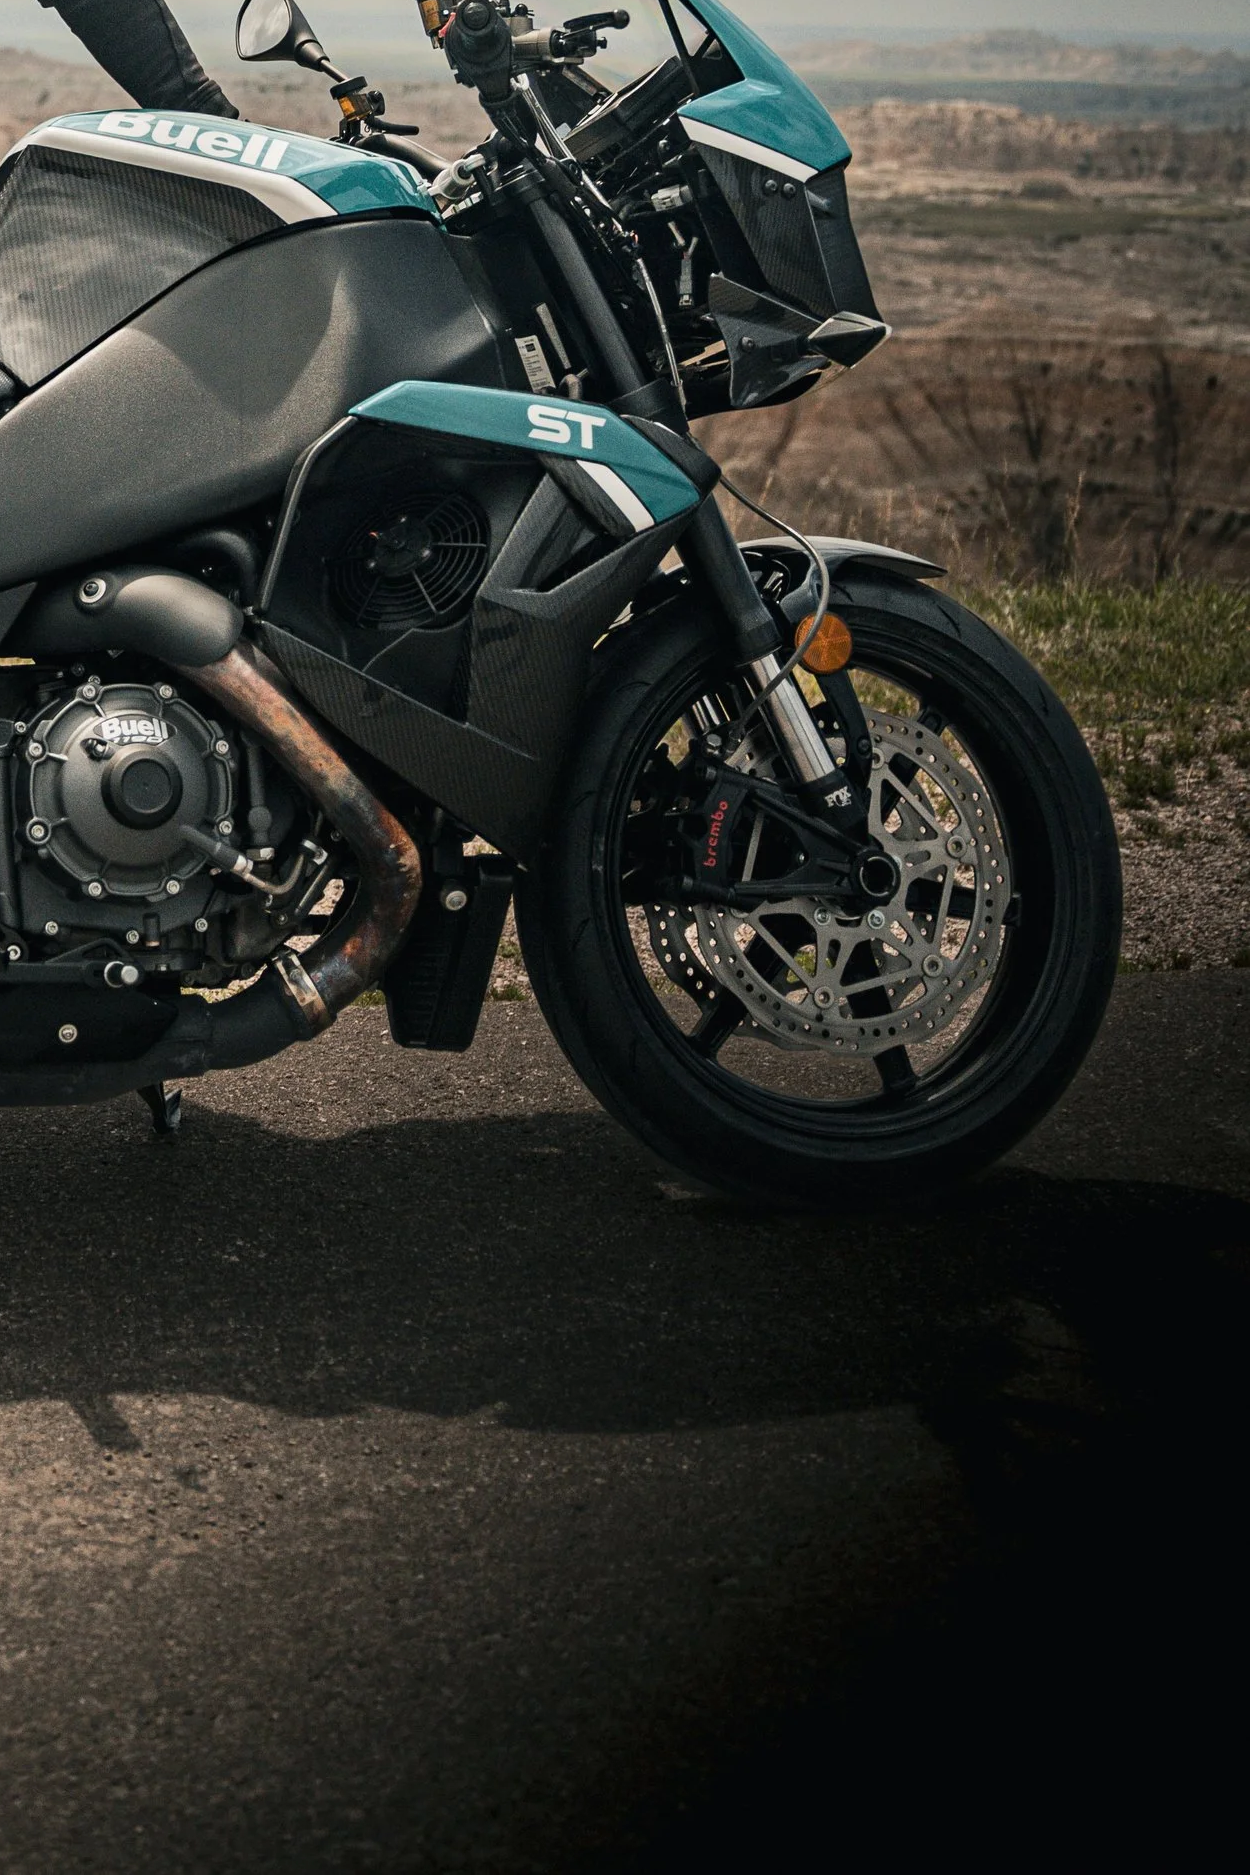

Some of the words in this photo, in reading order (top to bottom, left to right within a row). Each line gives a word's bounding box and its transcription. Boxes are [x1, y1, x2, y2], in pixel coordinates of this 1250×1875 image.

[97, 111, 290, 171] Buell
[527, 404, 607, 450] ST
[102, 717, 168, 739] Buell
[703, 800, 728, 866] brembo
